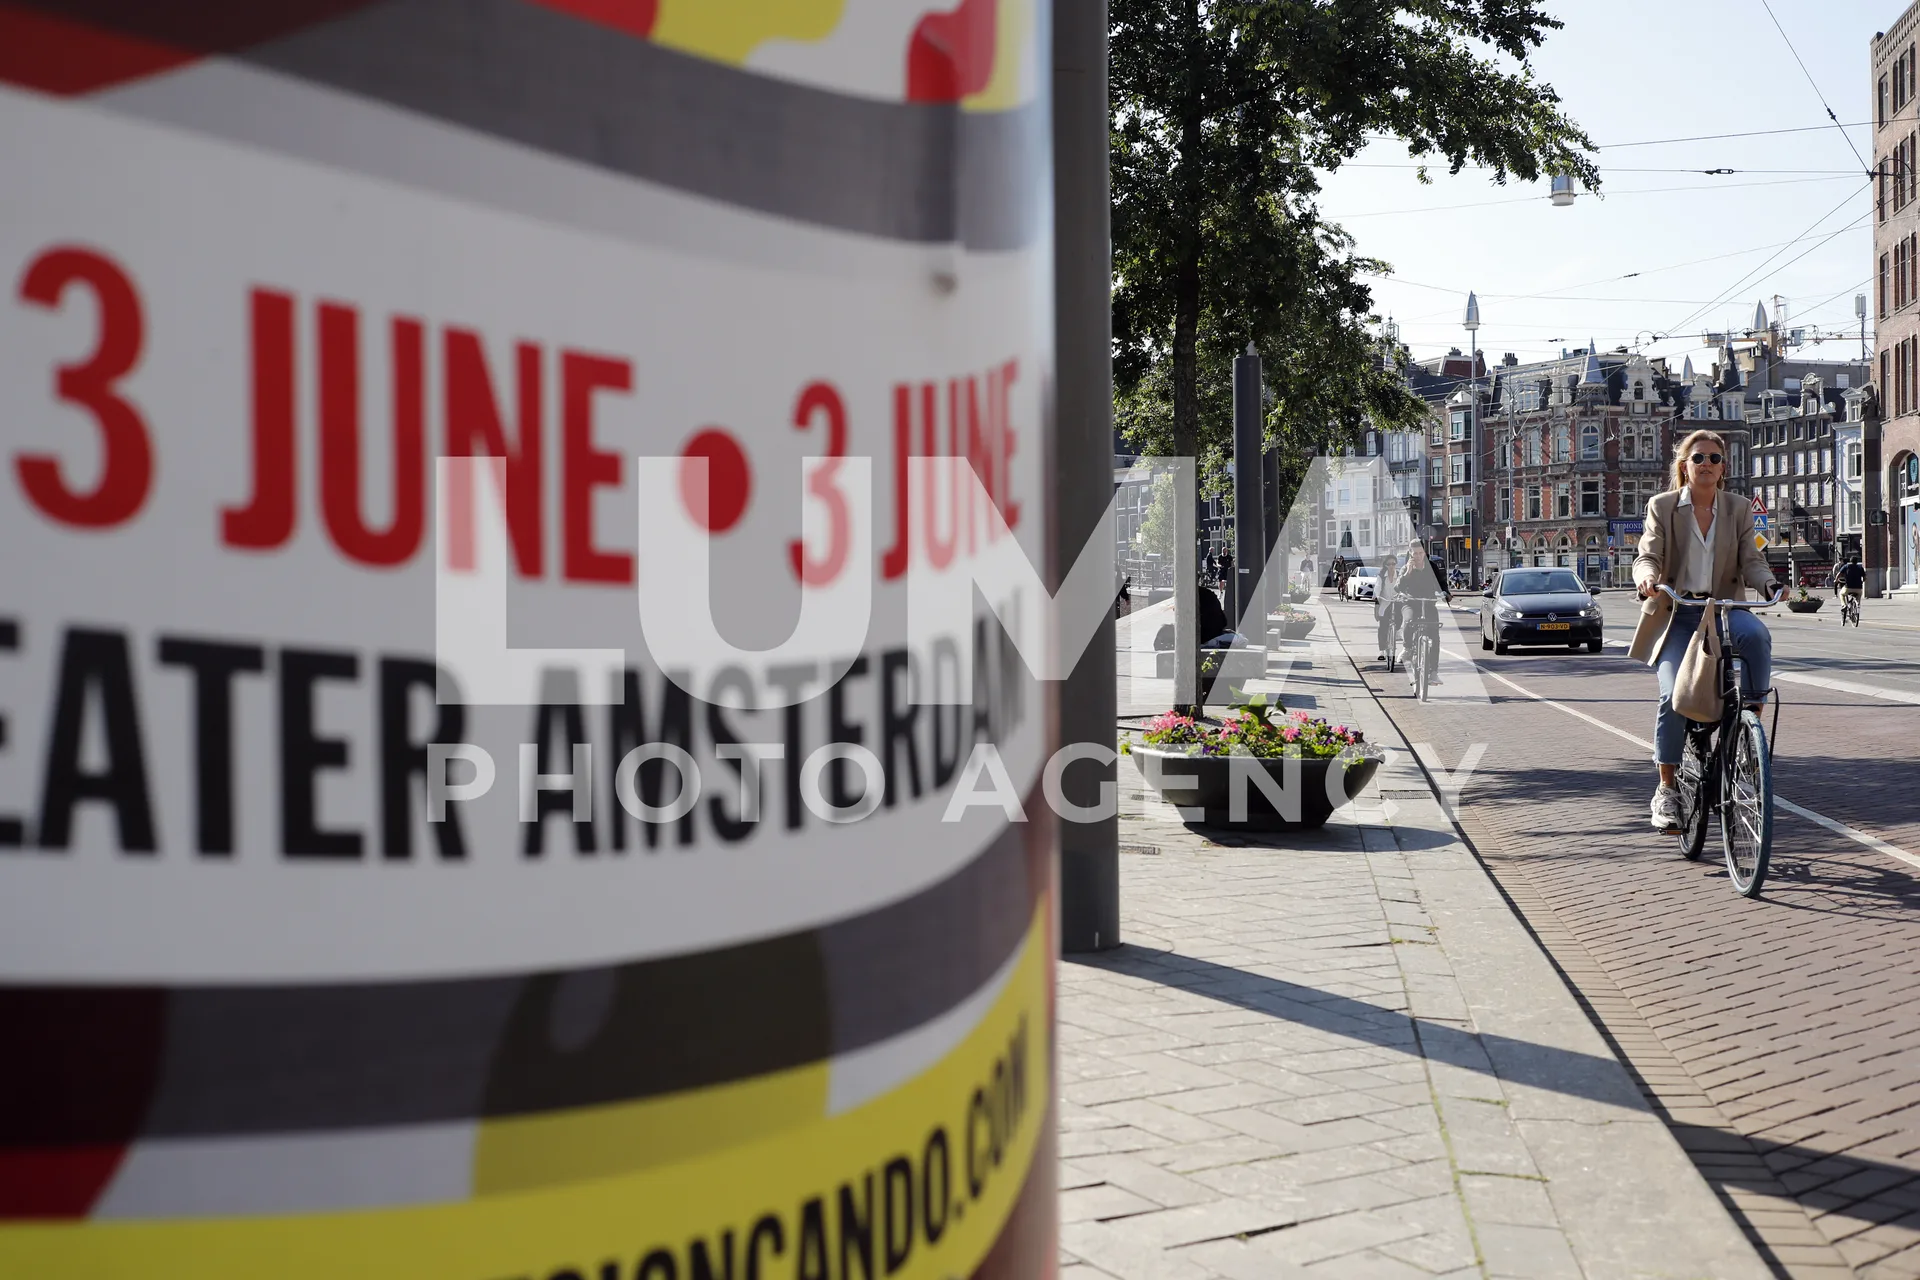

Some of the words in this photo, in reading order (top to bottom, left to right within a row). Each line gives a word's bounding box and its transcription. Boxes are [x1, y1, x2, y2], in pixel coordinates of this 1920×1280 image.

[13, 243, 155, 531] 3
[219, 284, 635, 584] JUNE
[788, 380, 852, 590] 3
[881, 357, 1022, 584] JUNE
[0, 617, 470, 859] ATER
[520, 587, 1026, 860] AMSTERDAM
